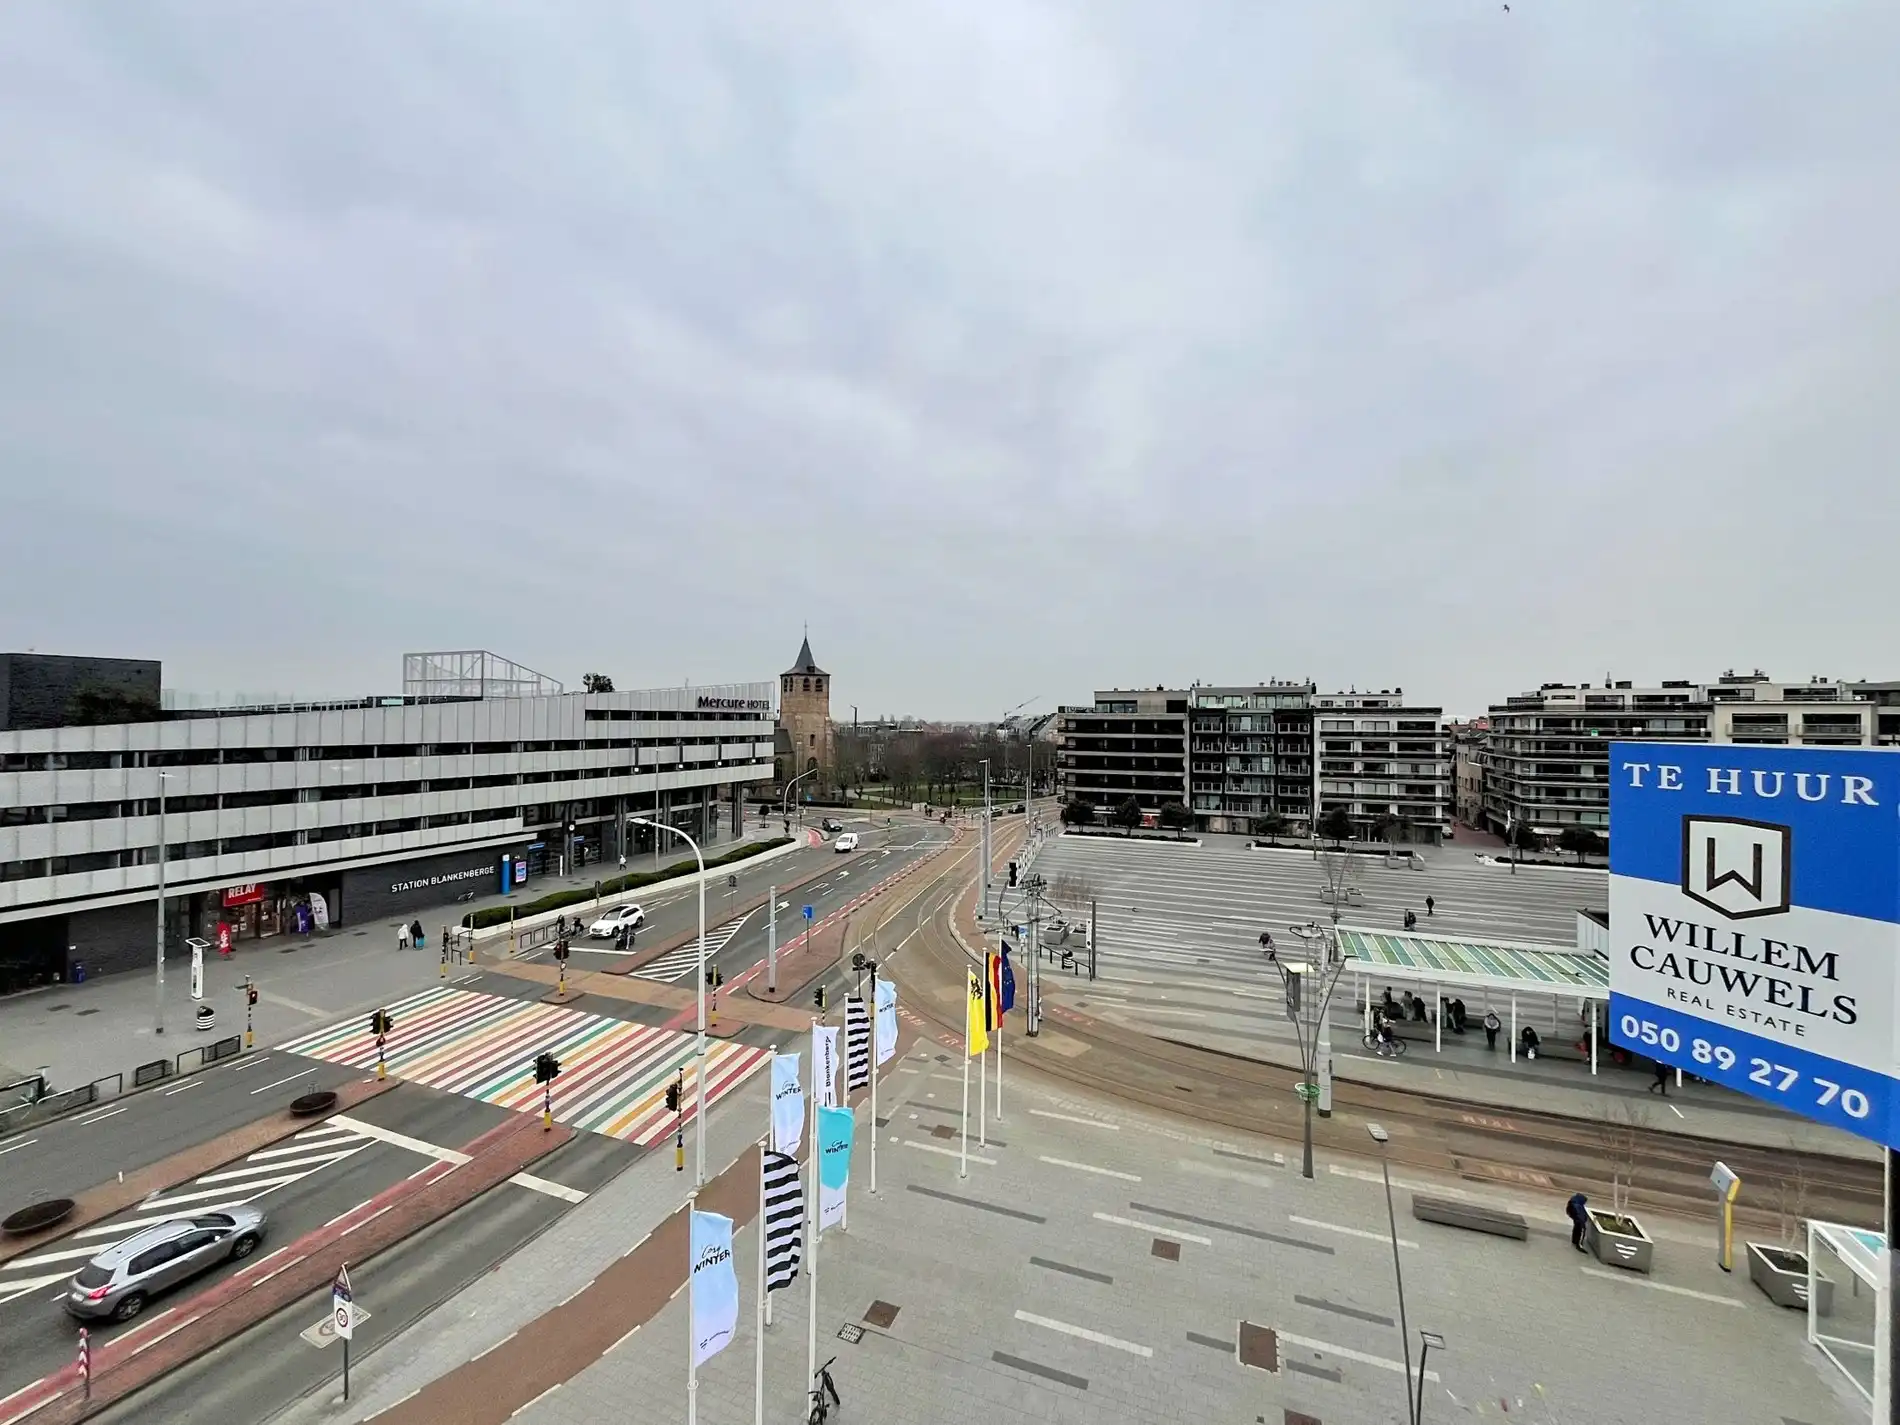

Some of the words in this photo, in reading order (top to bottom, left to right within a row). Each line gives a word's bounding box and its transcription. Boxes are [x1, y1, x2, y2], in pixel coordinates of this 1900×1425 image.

[698, 696, 745, 709] Mercure
[747, 700, 770, 710] HOTEL
[1623, 762, 1683, 791] TE
[1706, 768, 1879, 806] HUUR
[228, 883, 257, 899] RELAY
[391, 878, 429, 893] STATION
[431, 865, 495, 885] BLANKENBERGE
[1643, 913, 1839, 981] WILLEM
[1630, 945, 1857, 1025] CAUWELS
[1667, 987, 1714, 1010] REAL
[1726, 1004, 1805, 1036] ESTATE
[1621, 1015, 1680, 1052] 050
[1691, 1039, 1736, 1070] 89
[1749, 1058, 1799, 1091] 27
[1813, 1077, 1870, 1118] 70
[775, 1085, 802, 1101] WINTER
[693, 1249, 731, 1274] WINTER
